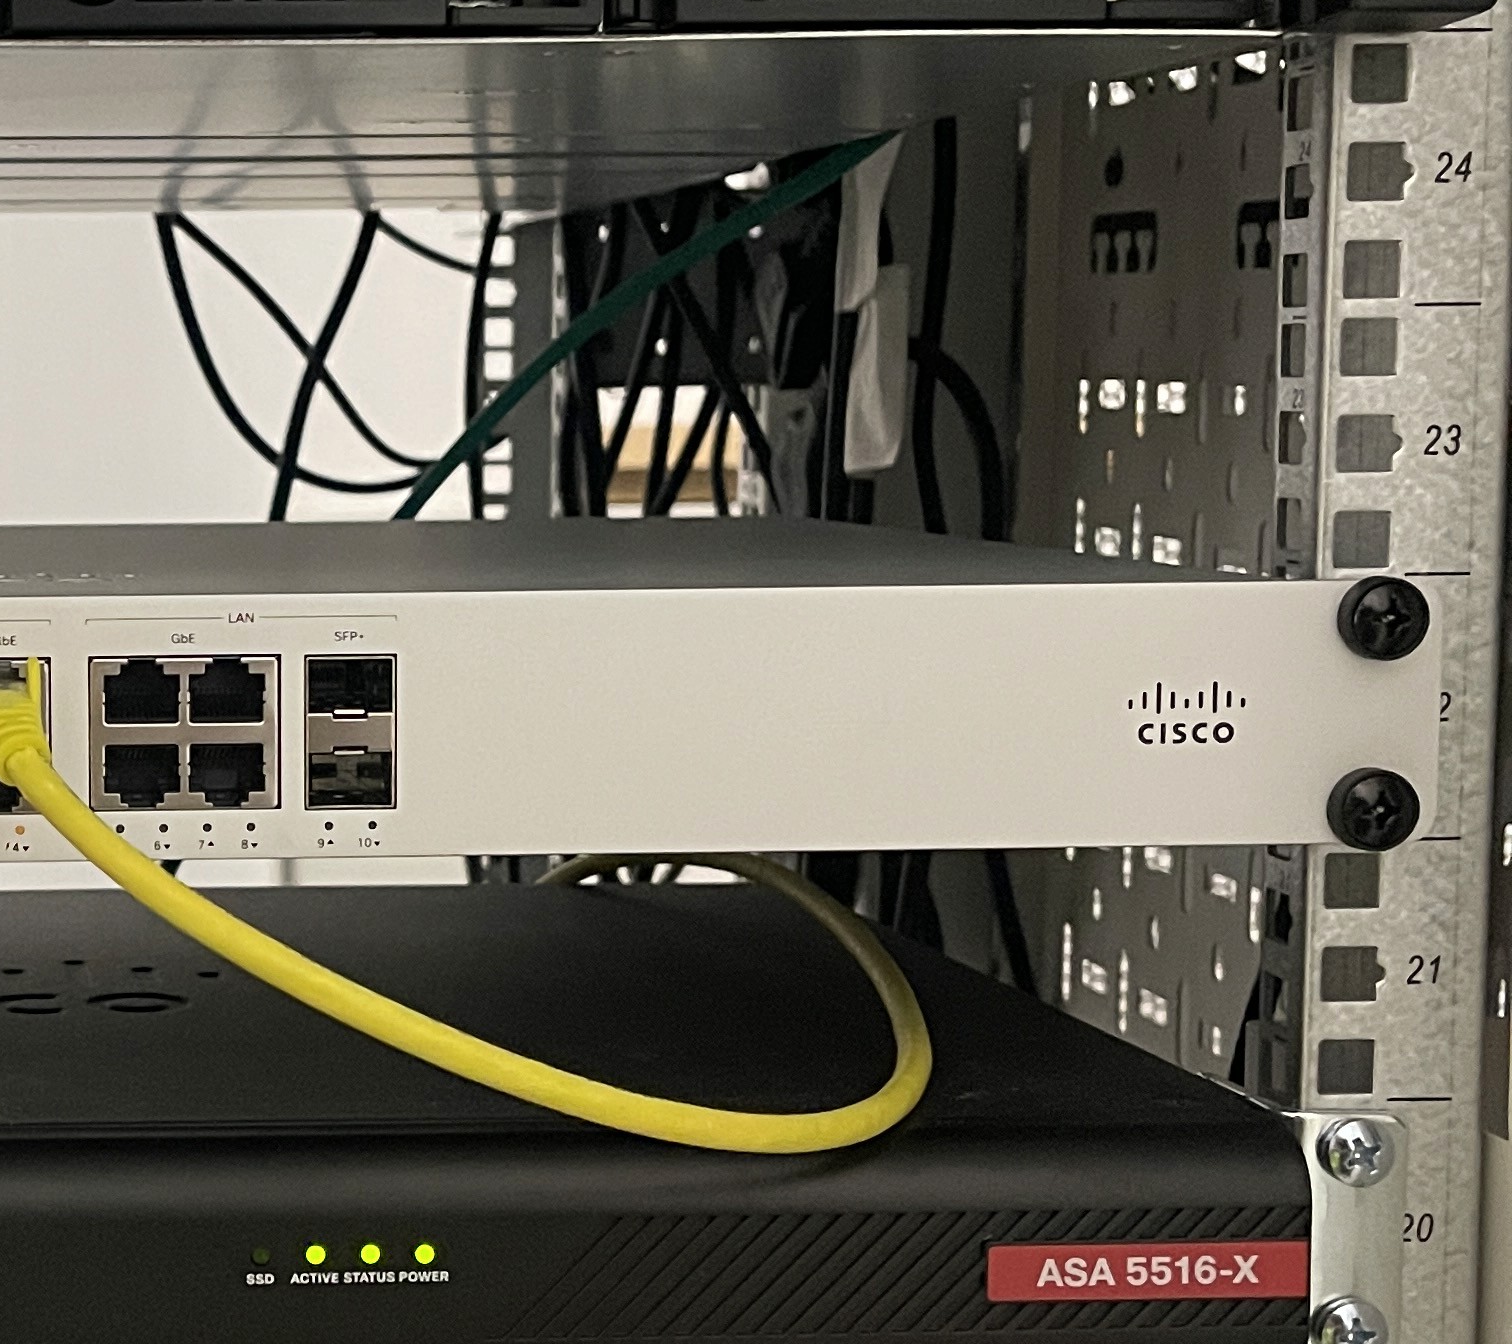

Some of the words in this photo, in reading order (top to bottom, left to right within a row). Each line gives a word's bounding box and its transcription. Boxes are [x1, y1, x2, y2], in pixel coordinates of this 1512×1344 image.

[1434, 151, 1473, 183] 24
[1424, 424, 1462, 456] 23
[227, 612, 255, 624] LAN
[170, 633, 196, 644] GbE
[358, 838, 372, 848] 10
[1406, 955, 1442, 985] 21
[1403, 1213, 1435, 1243] 20
[246, 1273, 275, 1285] SSD
[290, 1272, 339, 1284] ACTIVE
[343, 1271, 396, 1283] STATUS
[398, 1270, 450, 1282] POWER
[1036, 1256, 1116, 1288] ASA
[1125, 1254, 1260, 1286] 5516-X
